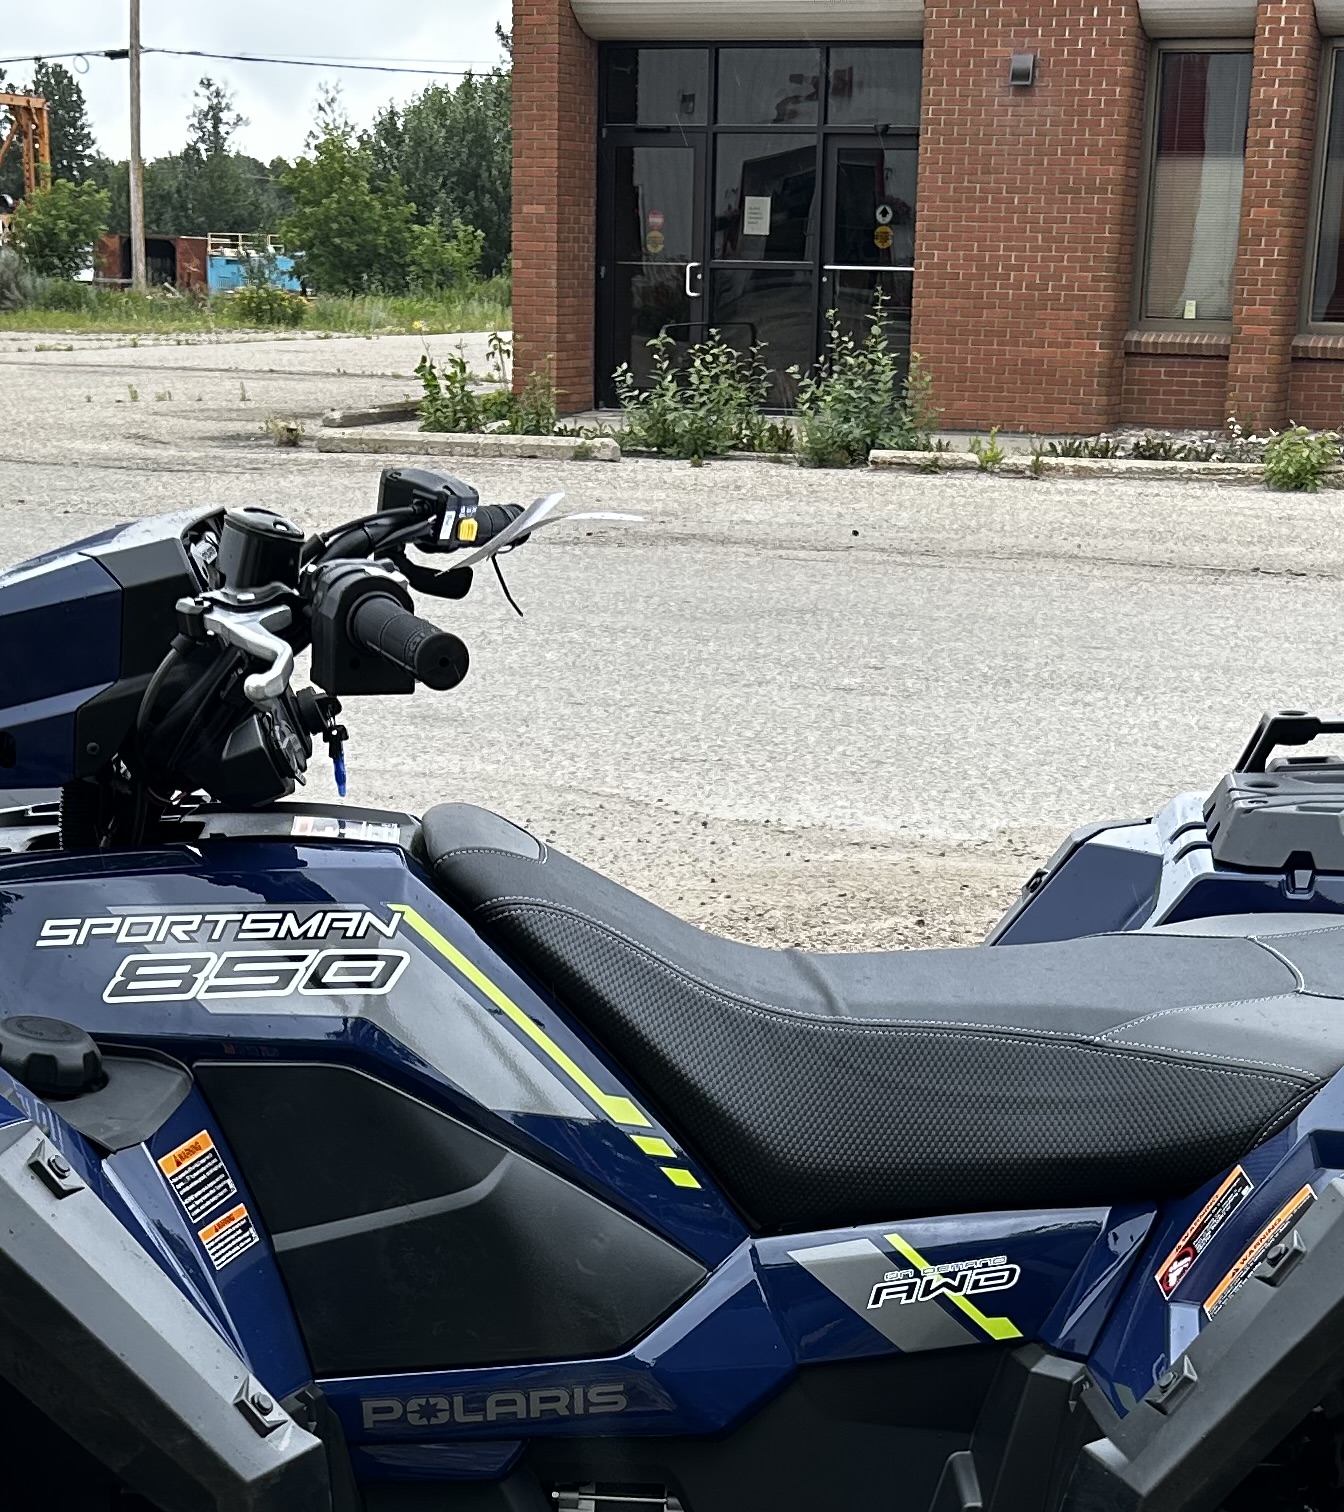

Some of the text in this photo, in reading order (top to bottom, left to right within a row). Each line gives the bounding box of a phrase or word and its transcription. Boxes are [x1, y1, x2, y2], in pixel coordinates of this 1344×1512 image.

[35, 910, 402, 947] SPORTSMAN
[102, 948, 411, 1005] 850
[1240, 1217, 1282, 1265] WARNING
[866, 1263, 1021, 1310] AWD
[361, 1383, 629, 1429] POLARIS
